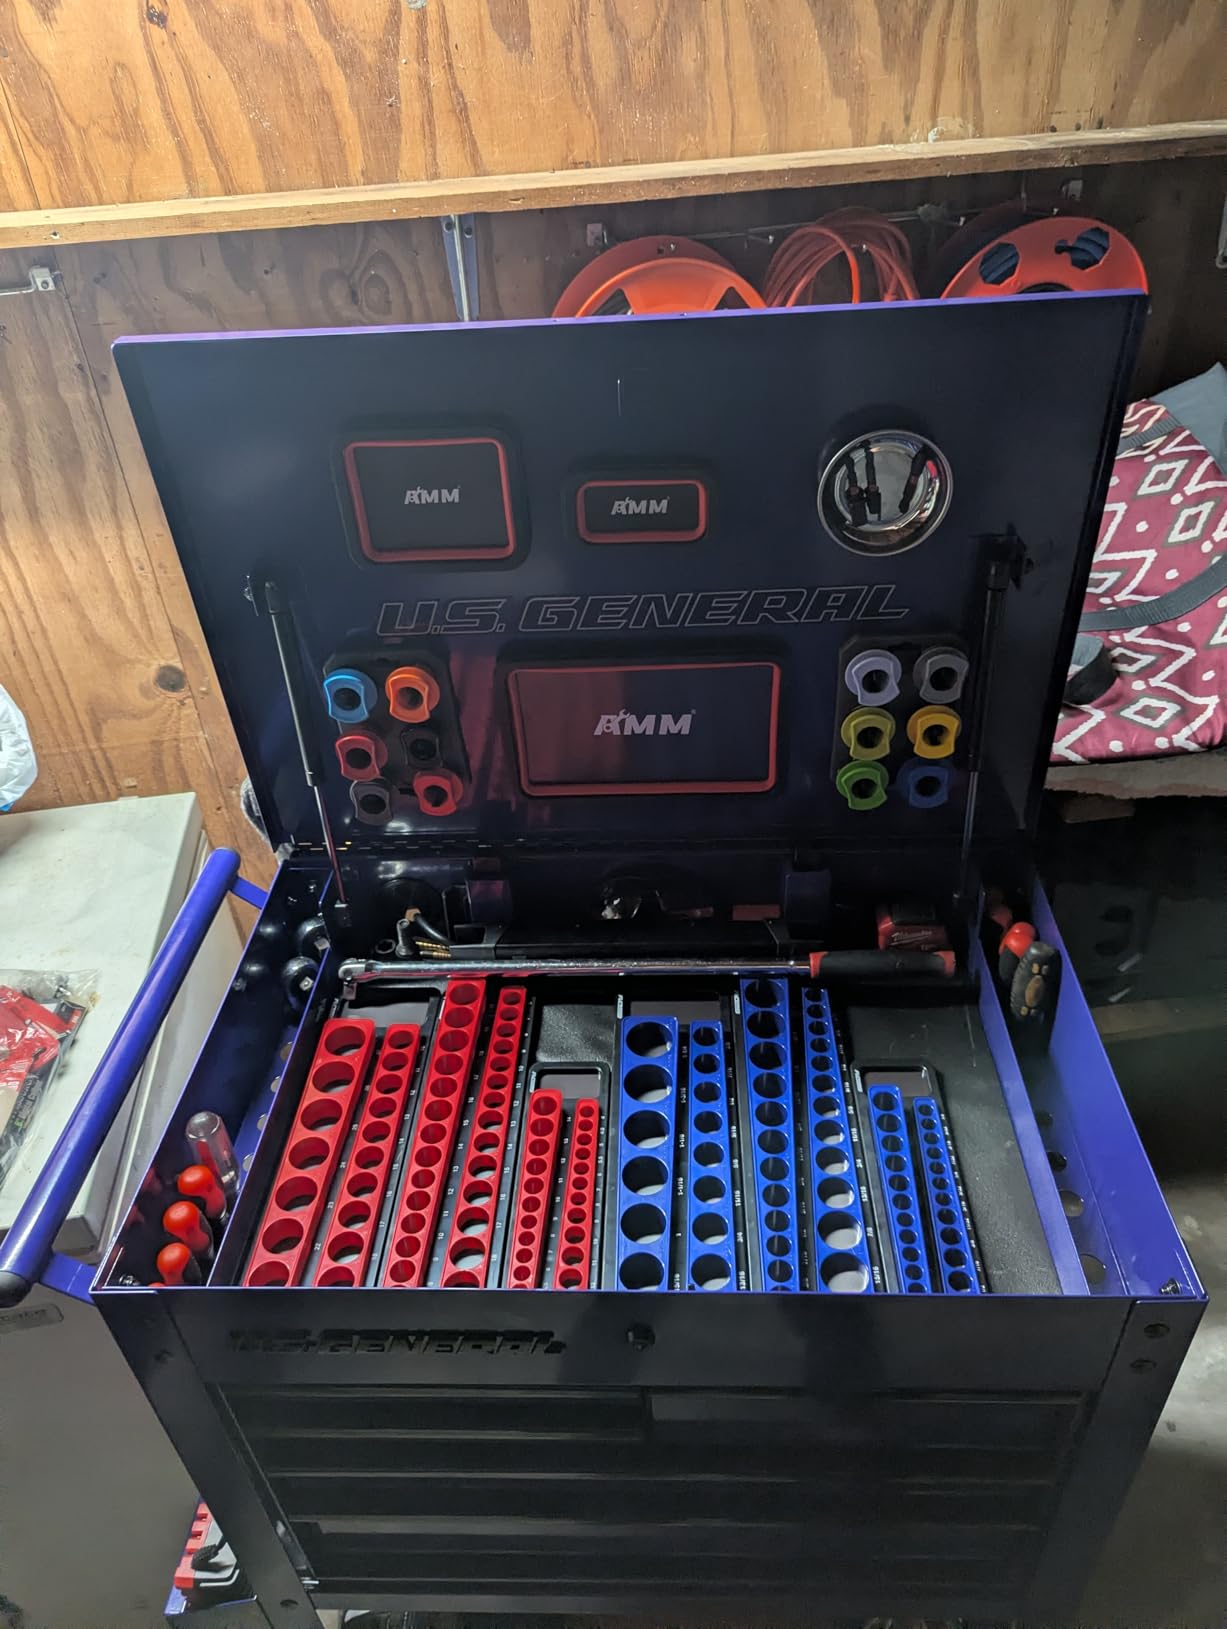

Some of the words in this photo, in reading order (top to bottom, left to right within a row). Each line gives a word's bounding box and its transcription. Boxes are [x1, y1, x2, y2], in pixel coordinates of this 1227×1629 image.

[376, 599, 507, 637] U.S.
[519, 584, 908, 632] GENERAL
[593, 709, 696, 735] AMM
